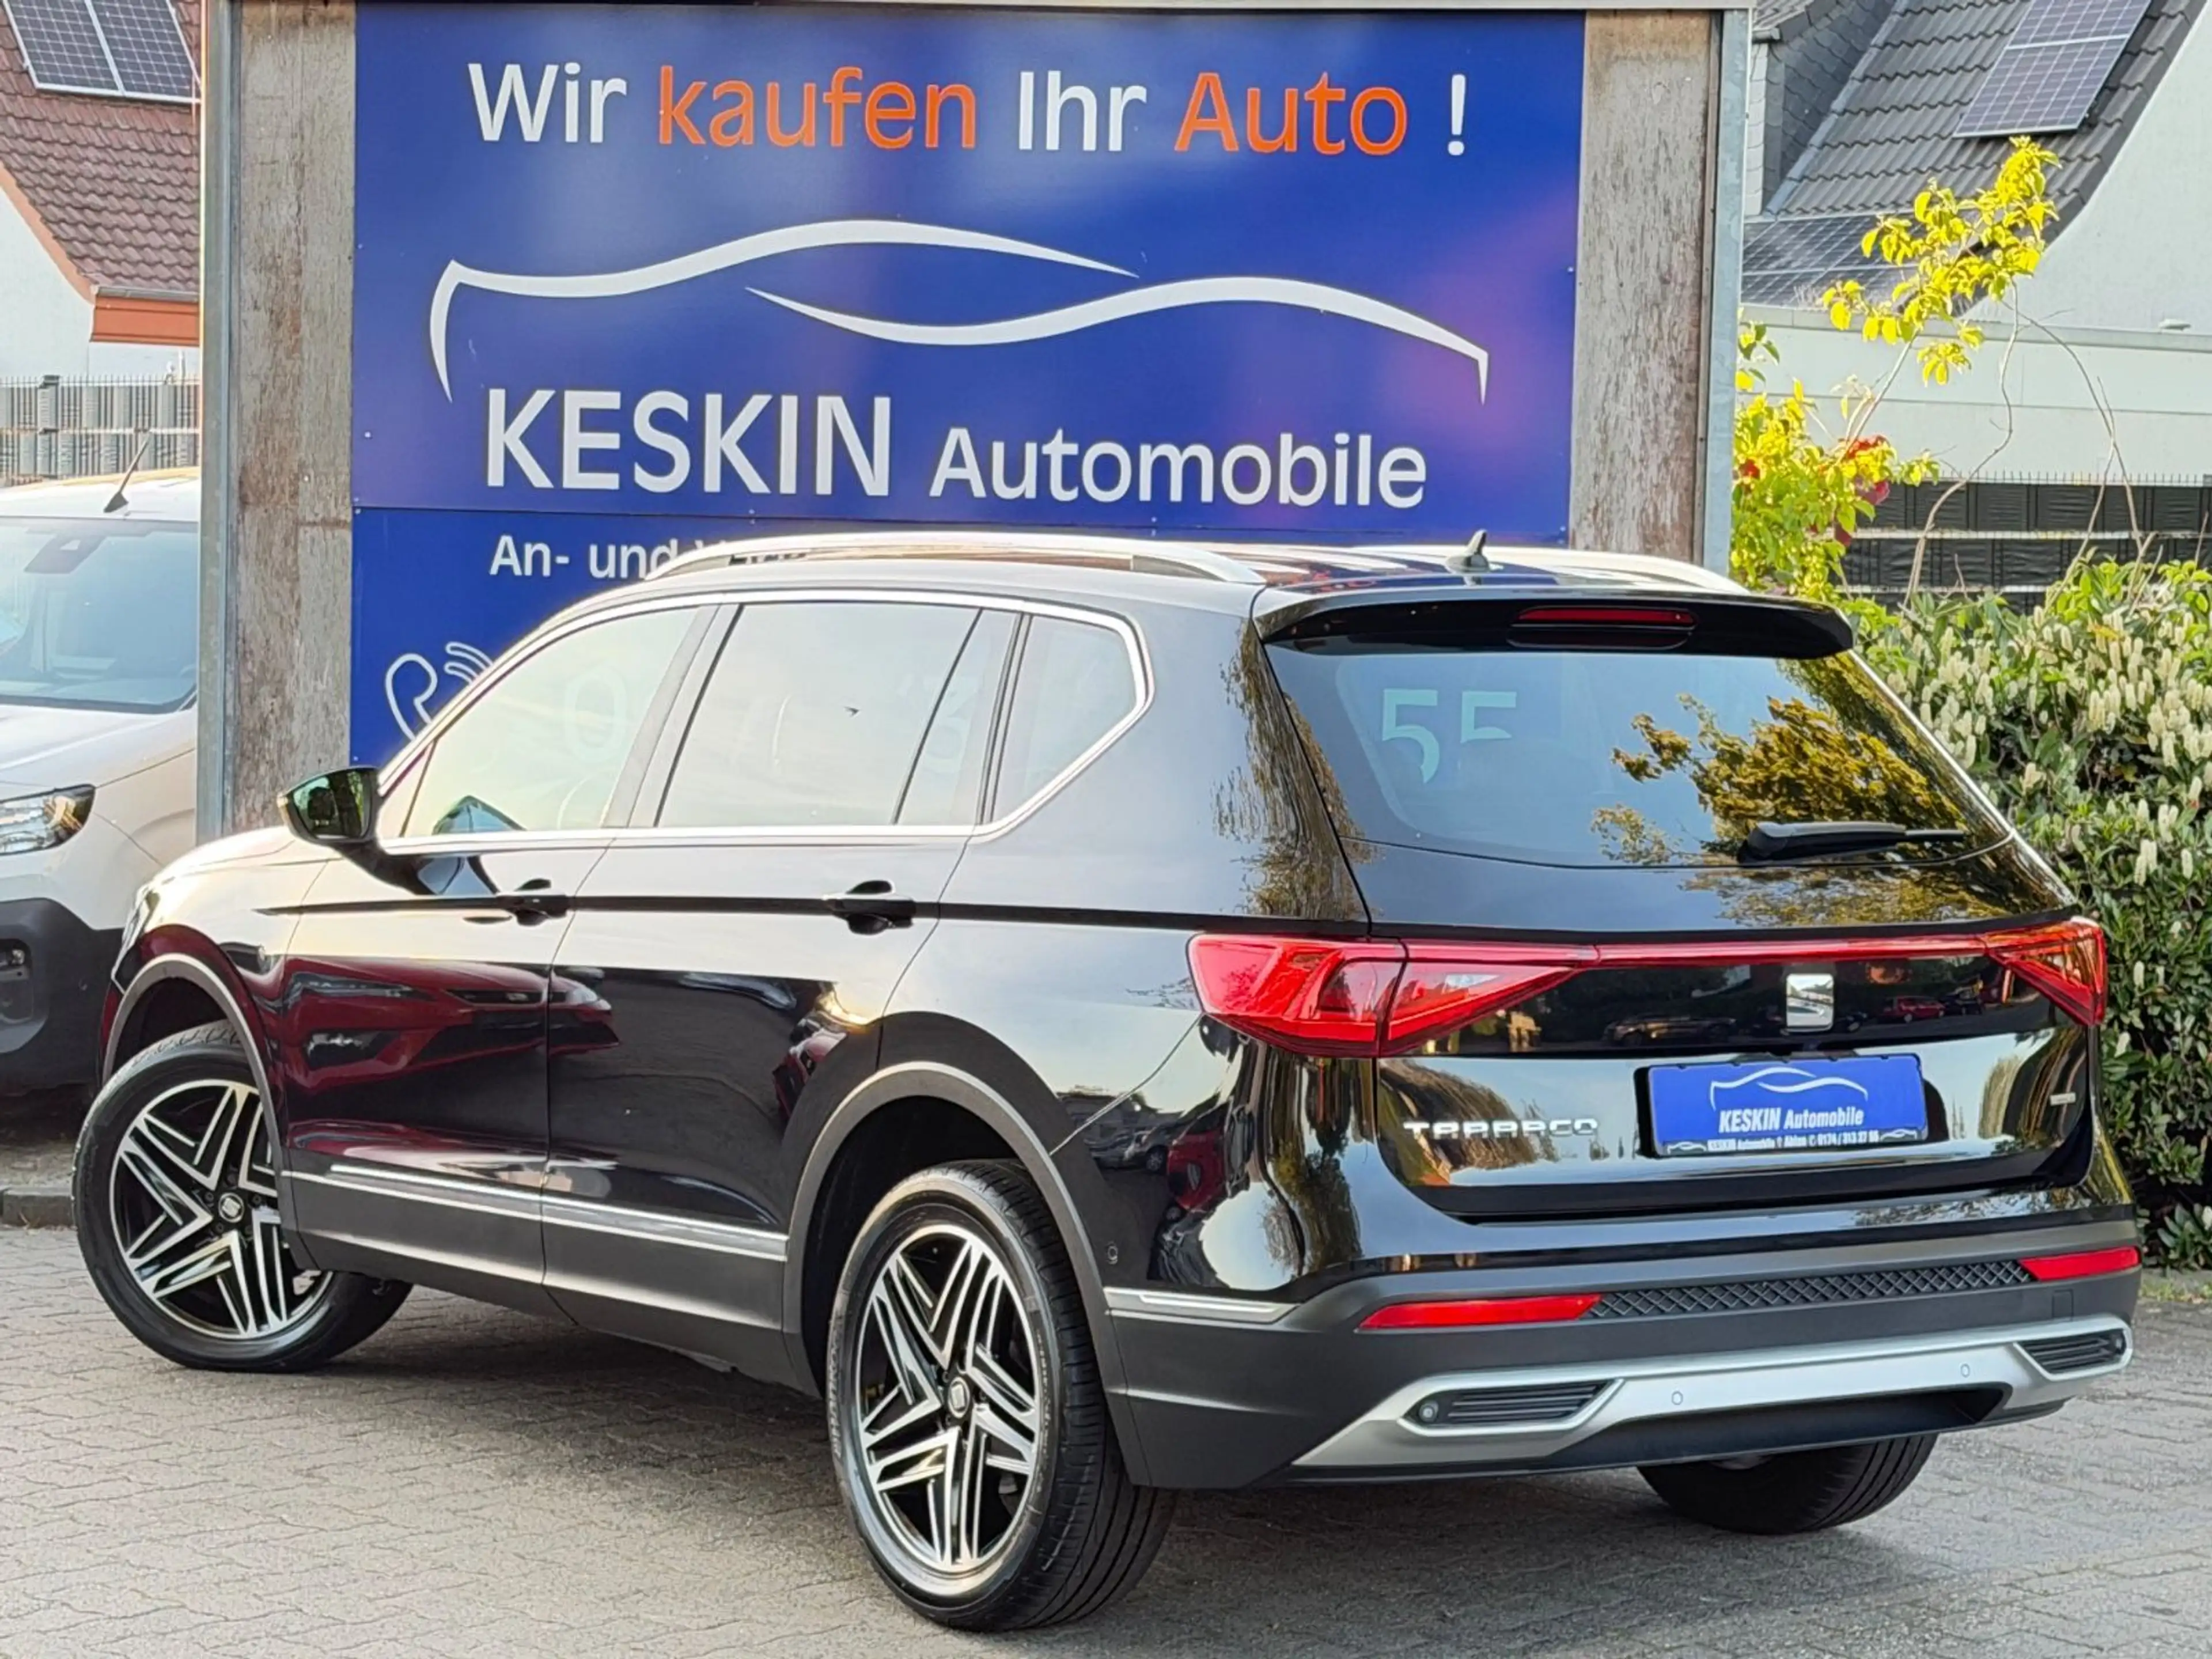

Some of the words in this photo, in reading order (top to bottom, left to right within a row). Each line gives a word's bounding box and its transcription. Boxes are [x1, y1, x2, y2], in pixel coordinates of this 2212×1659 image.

[467, 62, 627, 143] Wir
[659, 65, 976, 150] kaufen
[1018, 70, 1147, 151] Ihr
[1174, 71, 1408, 156] Auto
[1446, 74, 1467, 156] !
[487, 388, 891, 497] KESKIN
[929, 427, 1427, 509] Automobile
[490, 534, 570, 576] An-
[1718, 1107, 1781, 1133] KESKIN
[1783, 1106, 1865, 1130] Automobile
